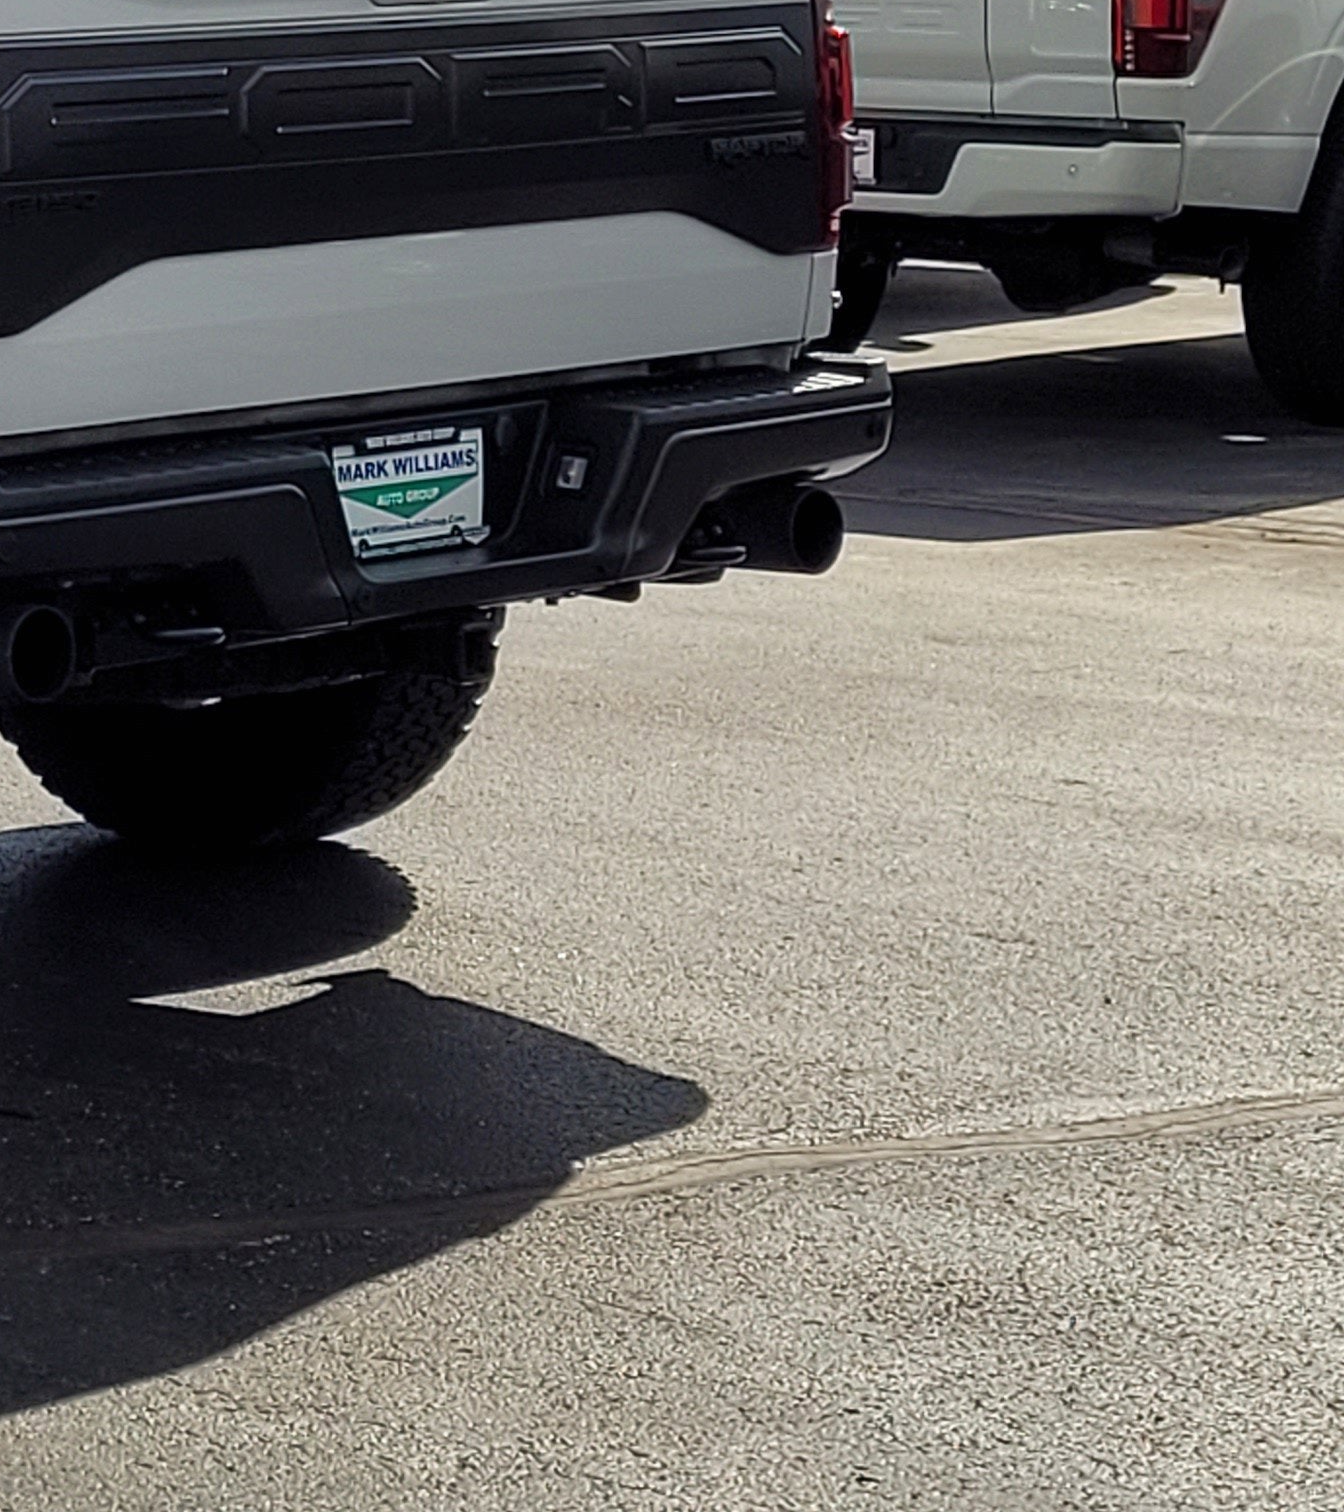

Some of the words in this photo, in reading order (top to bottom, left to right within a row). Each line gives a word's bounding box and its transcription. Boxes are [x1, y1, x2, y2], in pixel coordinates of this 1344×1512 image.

[337, 460, 389, 483] MARK
[393, 449, 476, 476] WILLIAMS
[376, 492, 403, 506] AUTO
[406, 487, 440, 503] GROUP
